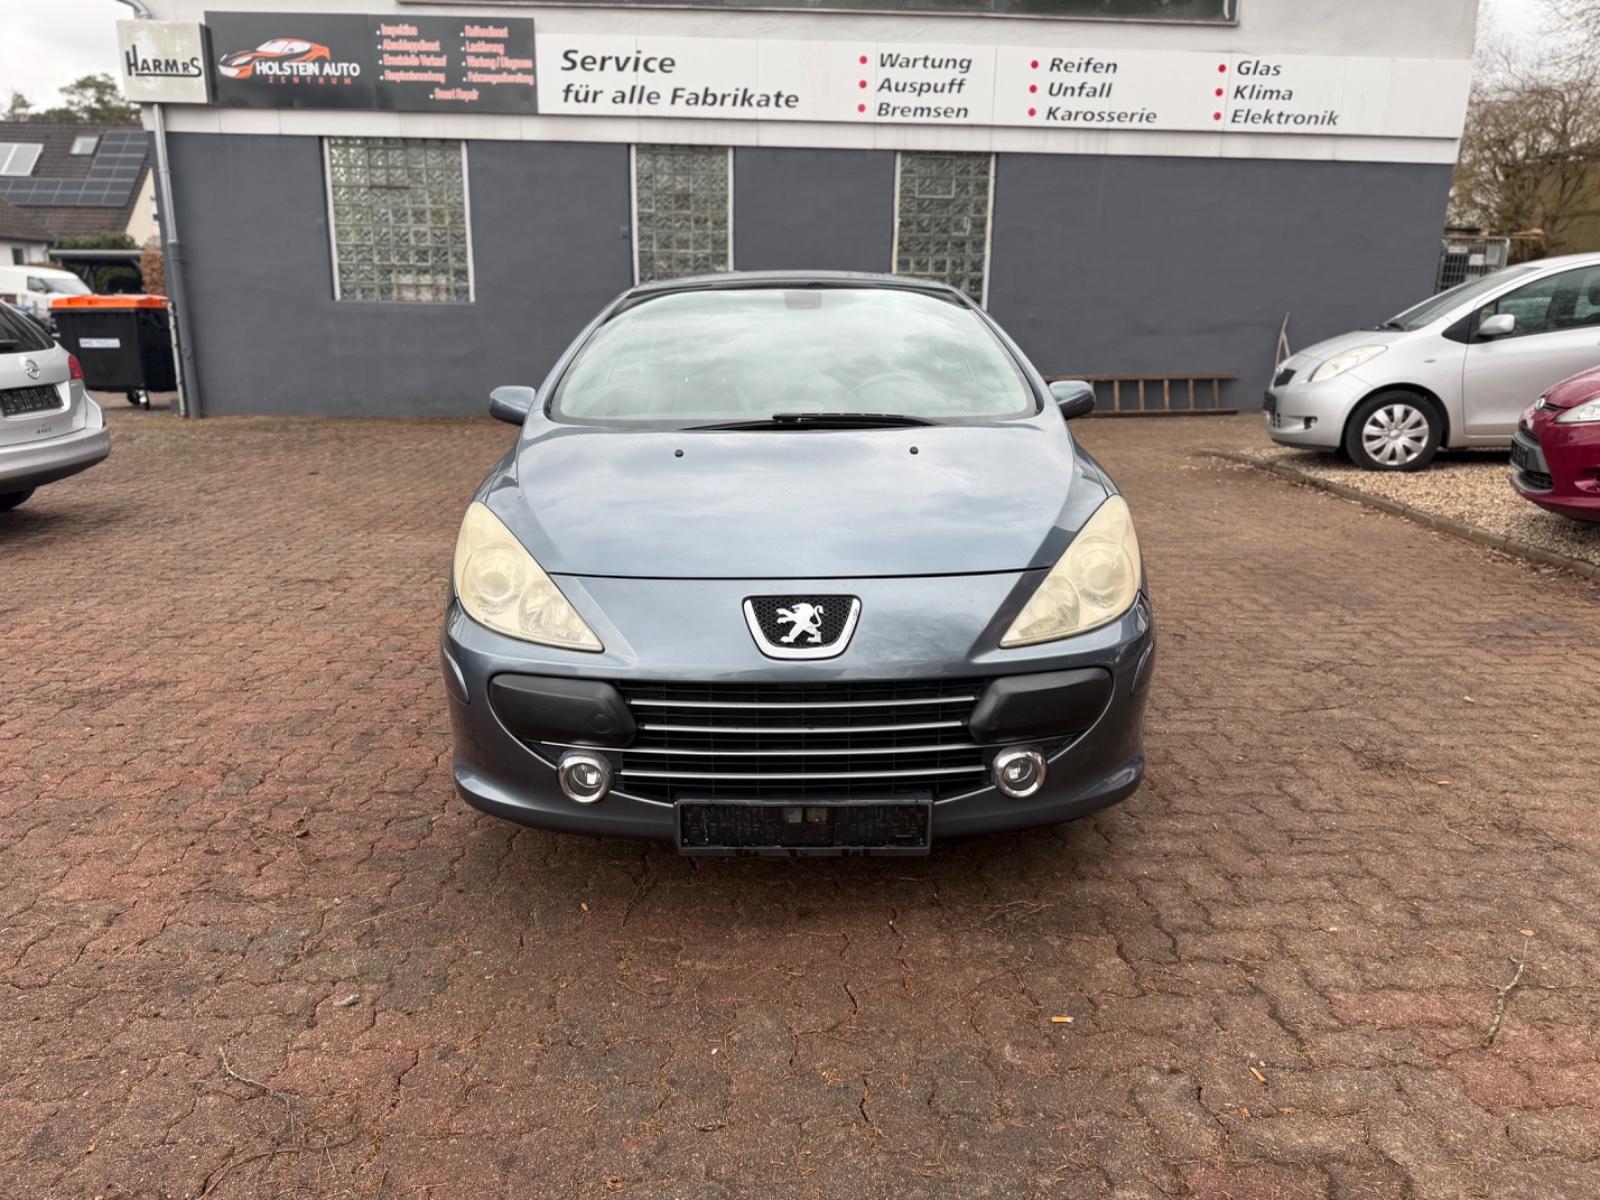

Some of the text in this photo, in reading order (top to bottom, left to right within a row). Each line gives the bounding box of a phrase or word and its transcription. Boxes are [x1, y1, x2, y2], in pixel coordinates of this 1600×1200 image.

[256, 62, 360, 76] HOLSTEIN AUTO
[561, 50, 675, 73] Service
[880, 53, 972, 73] Wartung
[1050, 57, 1117, 73] Reifen
[1238, 60, 1281, 76] Glas
[268, 76, 352, 84] ZENTRUM
[877, 78, 966, 97] Auspuff
[563, 84, 799, 108] für alle Fabrikate
[1049, 82, 1112, 98] Unfall
[1234, 85, 1293, 100] Klima
[877, 103, 968, 118] Bremsen
[1046, 107, 1157, 123] Karosserie
[1231, 109, 1338, 125] Elektronik
